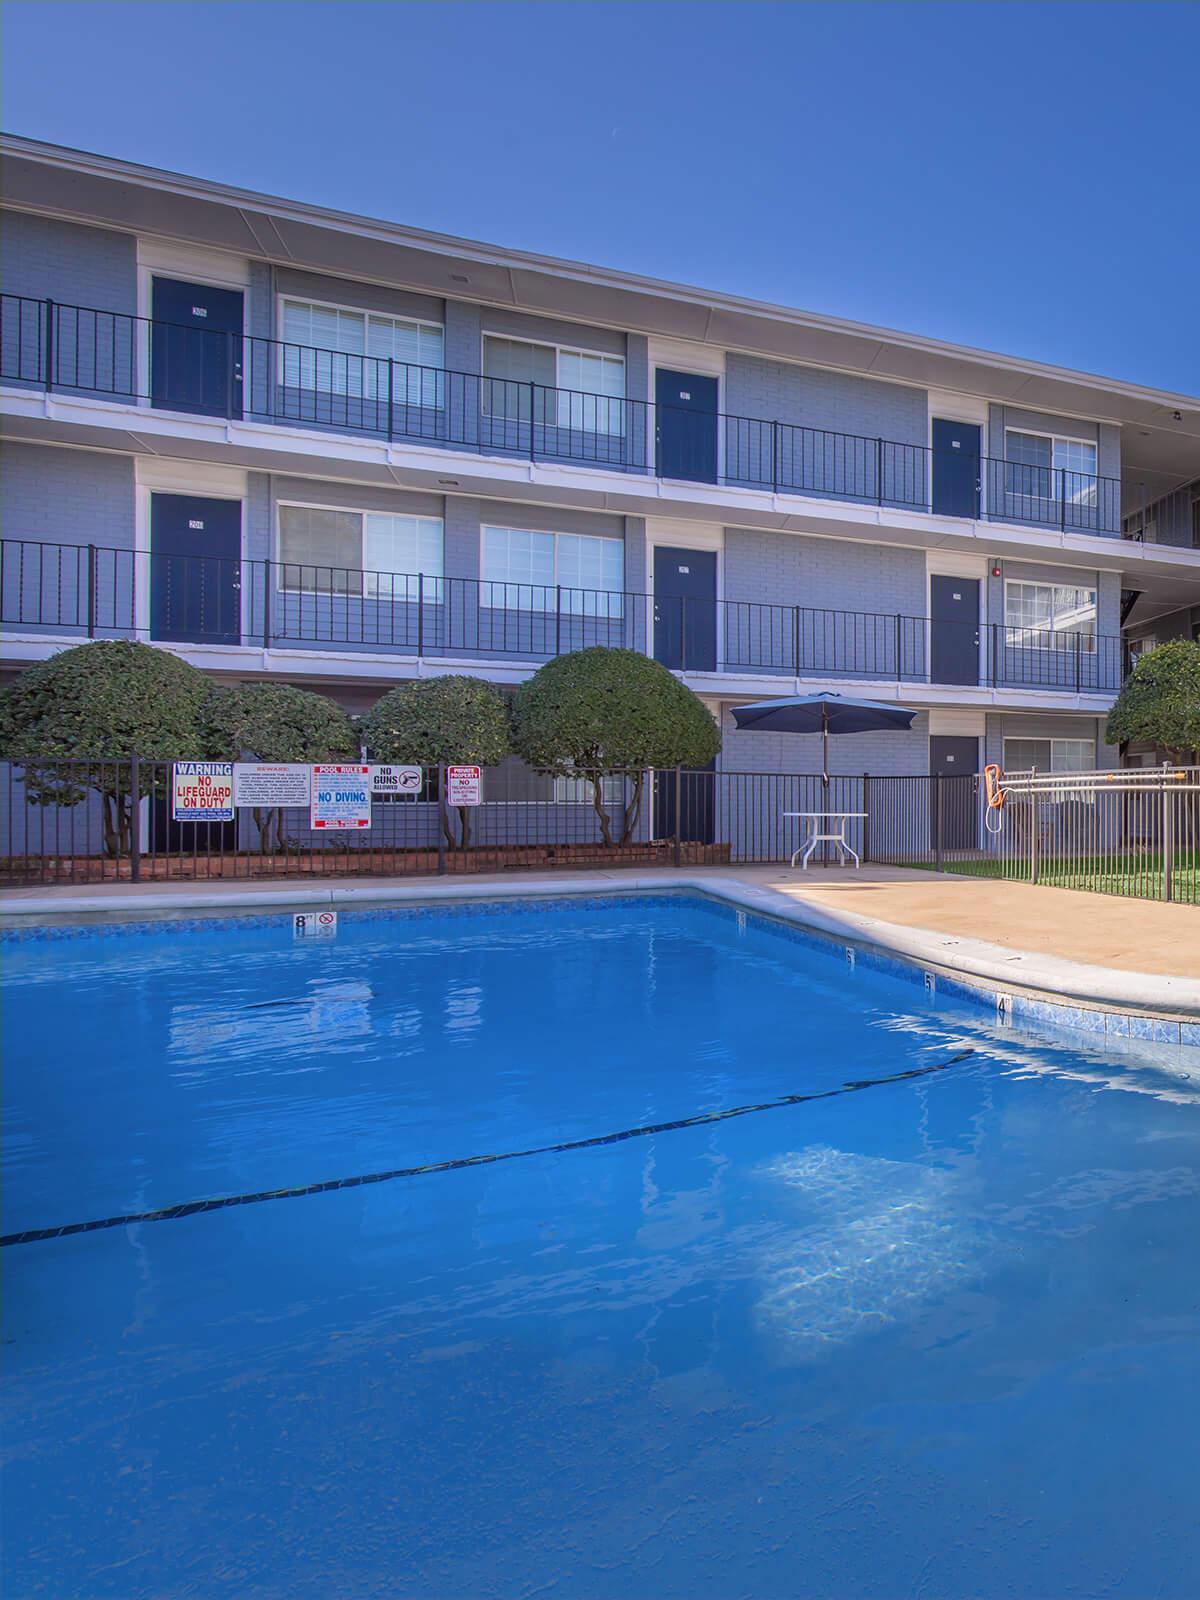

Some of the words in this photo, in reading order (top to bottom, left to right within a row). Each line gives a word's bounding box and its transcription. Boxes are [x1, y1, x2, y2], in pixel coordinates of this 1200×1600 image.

[177, 764, 232, 775] WARNING
[380, 767, 392, 775] NO
[198, 776, 212, 786] NO
[374, 775, 398, 784] GUNS
[177, 786, 231, 797] LIFEGUARD
[318, 792, 332, 802] NO
[184, 798, 197, 807] ON
[200, 798, 225, 807] DUTY
[296, 915, 305, 928] 8
[998, 997, 1006, 1013] 4
